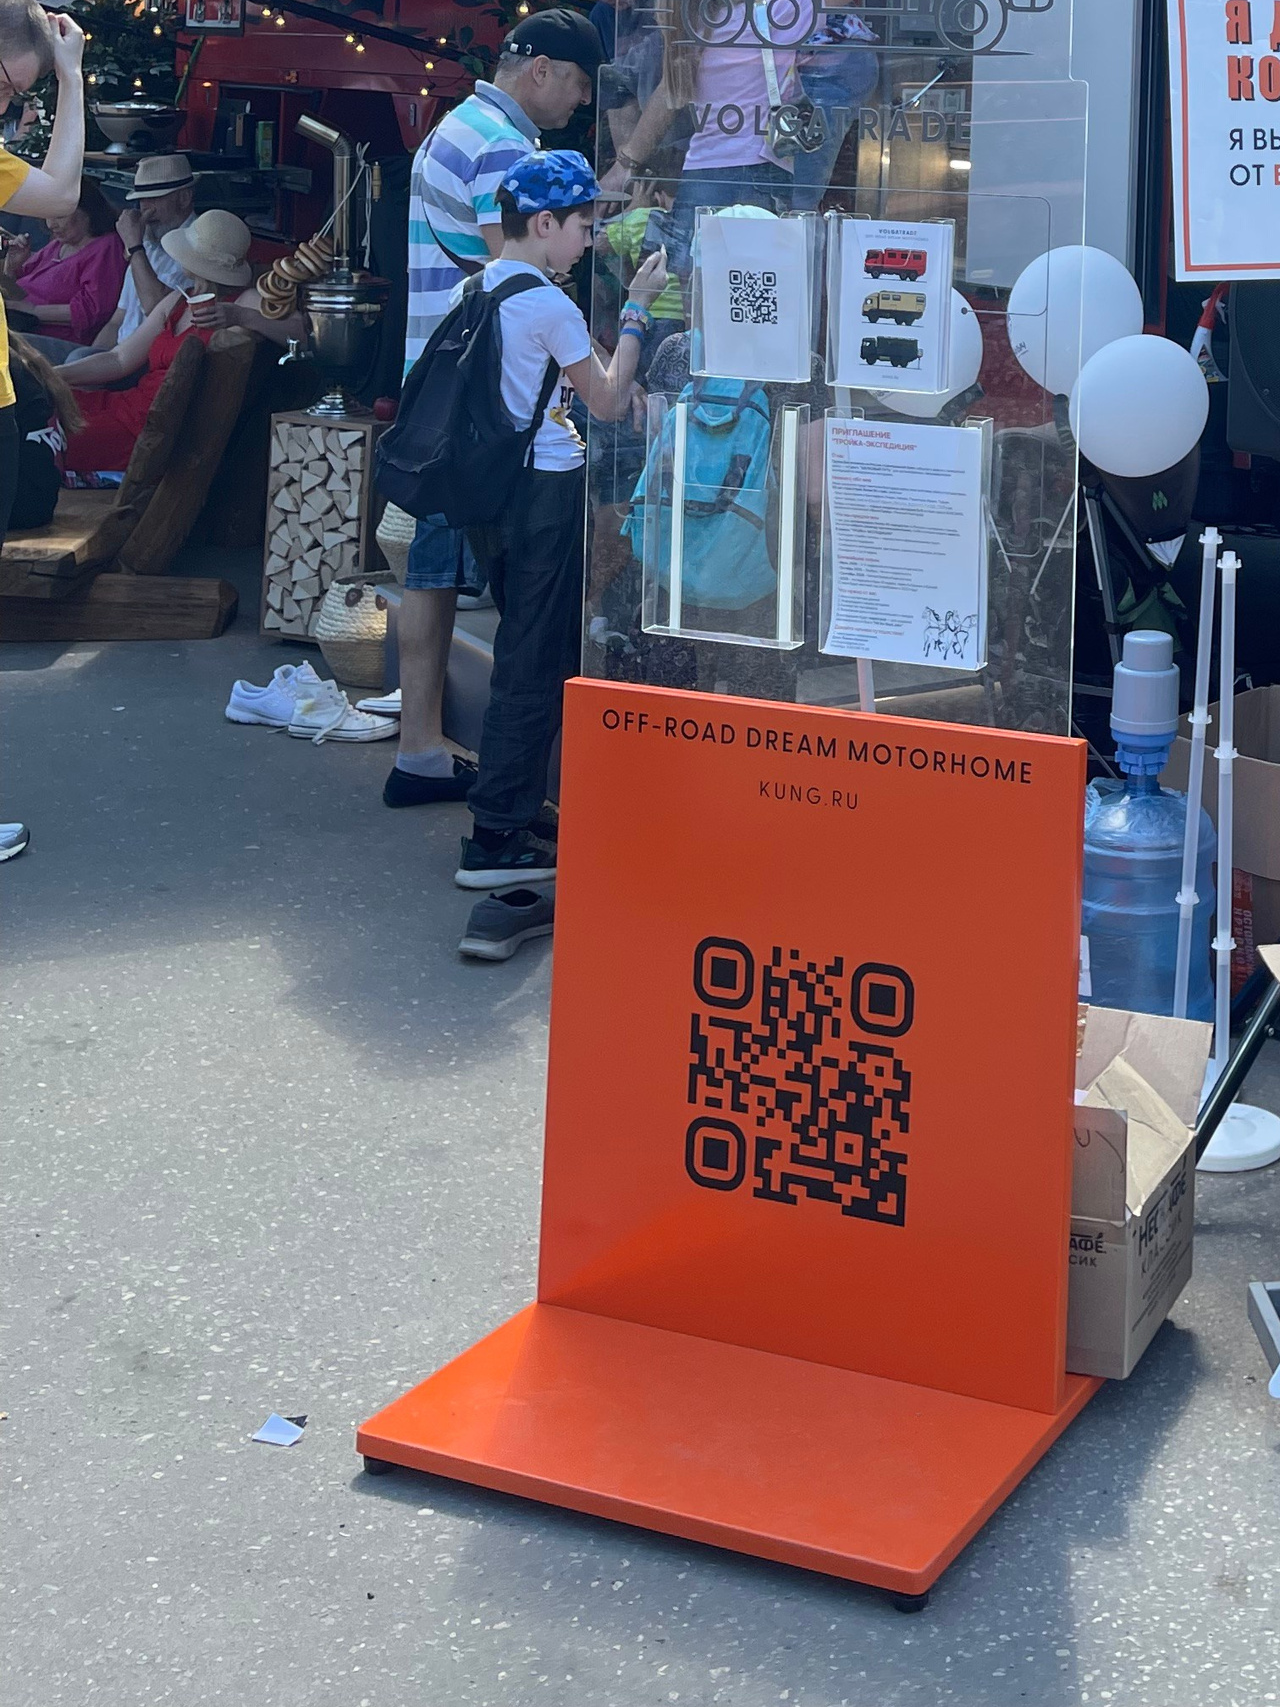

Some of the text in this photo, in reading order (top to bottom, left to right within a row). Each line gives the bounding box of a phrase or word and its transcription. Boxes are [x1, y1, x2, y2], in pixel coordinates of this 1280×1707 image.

[688, 101, 972, 144] VOLGATRADE
[1229, 128, 1244, 151] Я
[1229, 164, 1265, 187] ОТ
[602, 708, 1033, 784] OFF-ROAD DREAM MOTORHOME
[758, 779, 860, 810] KUNG.RU
